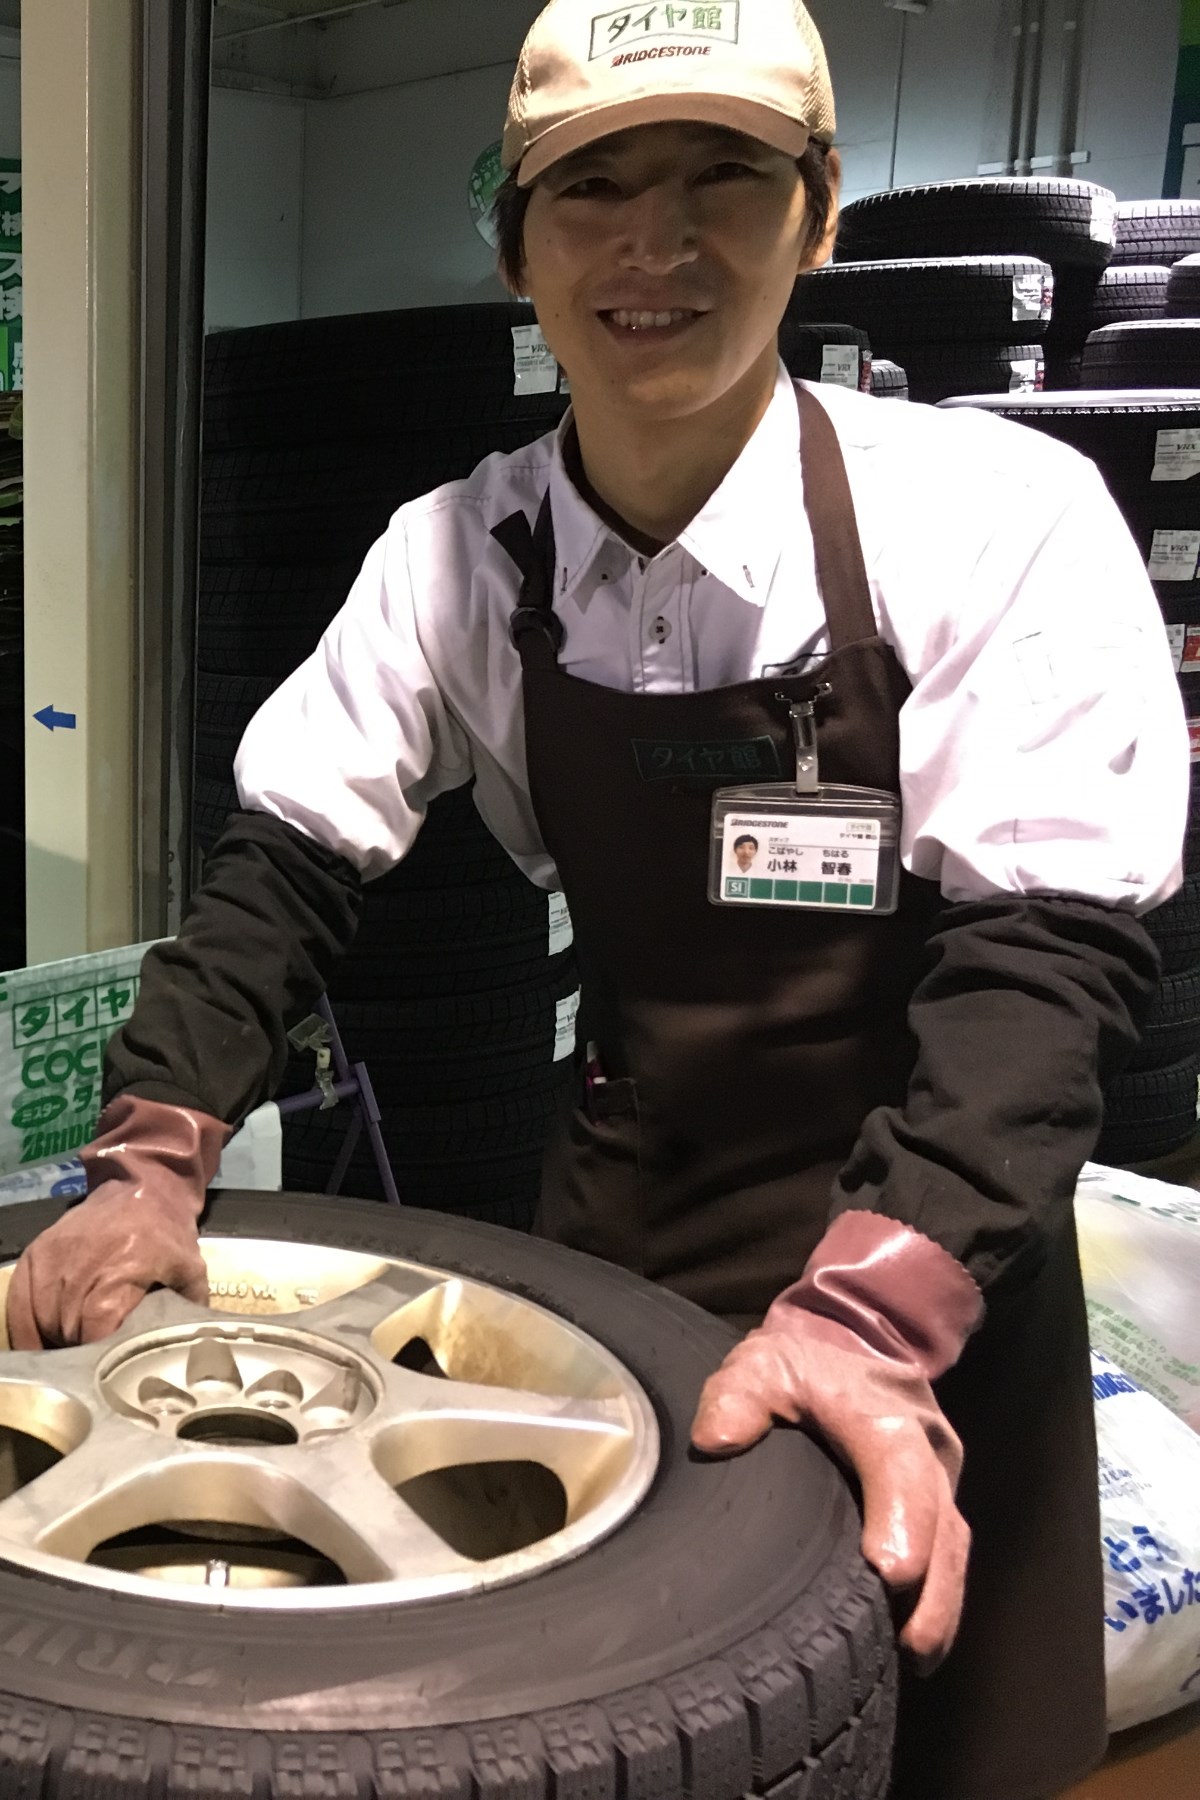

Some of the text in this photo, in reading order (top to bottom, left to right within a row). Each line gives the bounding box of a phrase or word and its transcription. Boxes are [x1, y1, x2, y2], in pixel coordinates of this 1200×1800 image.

[607, 4, 722, 43] タイヤ館
[611, 46, 711, 67] BRIDGESTONE
[730, 818, 789, 829] BRIDGESTONE
[768, 846, 850, 859] こばやし ちはる
[767, 858, 852, 876] 小林 智春
